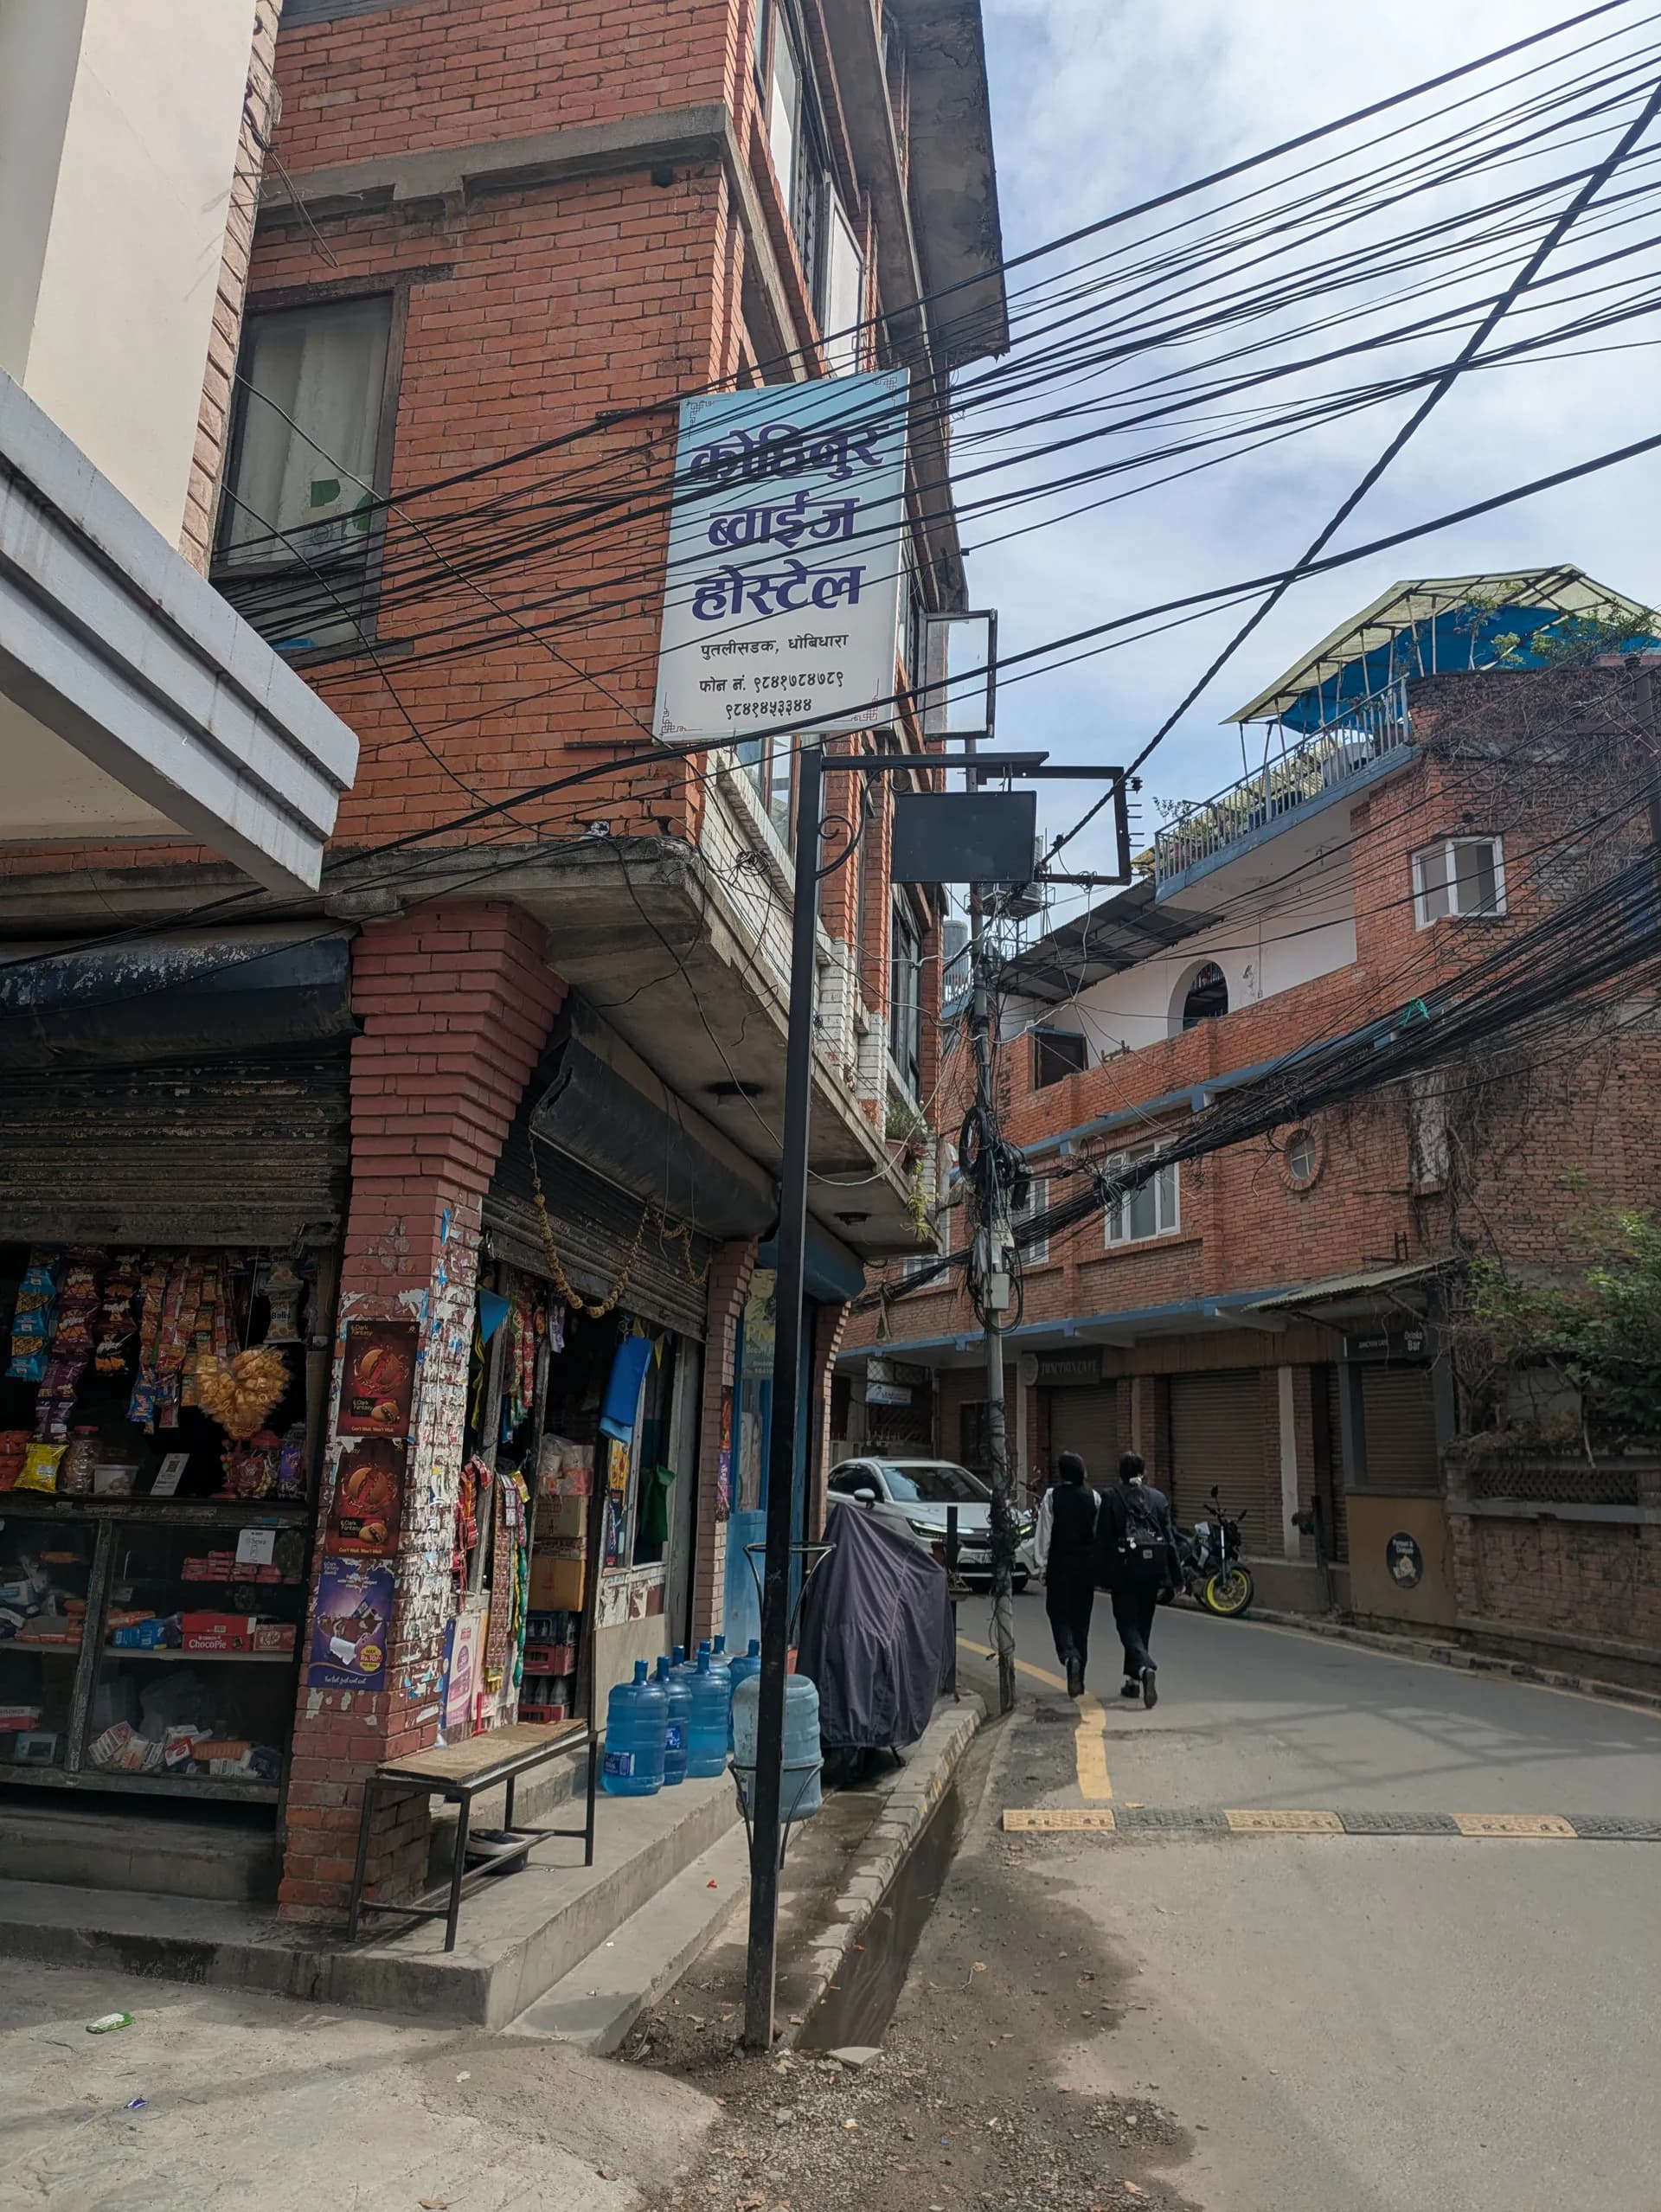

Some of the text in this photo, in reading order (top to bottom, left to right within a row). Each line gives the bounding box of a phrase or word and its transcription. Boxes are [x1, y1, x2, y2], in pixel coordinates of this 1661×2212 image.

[691, 559, 867, 620] होस्टेल
[701, 633, 849, 660] पुतलीसडक, धोबिधारा
[699, 671, 844, 693] फोन नं. ९८४१७८४७८९
[725, 698, 812, 720] ९८४१४५३३४४
[189, 1638, 227, 1649] ChocoPie
